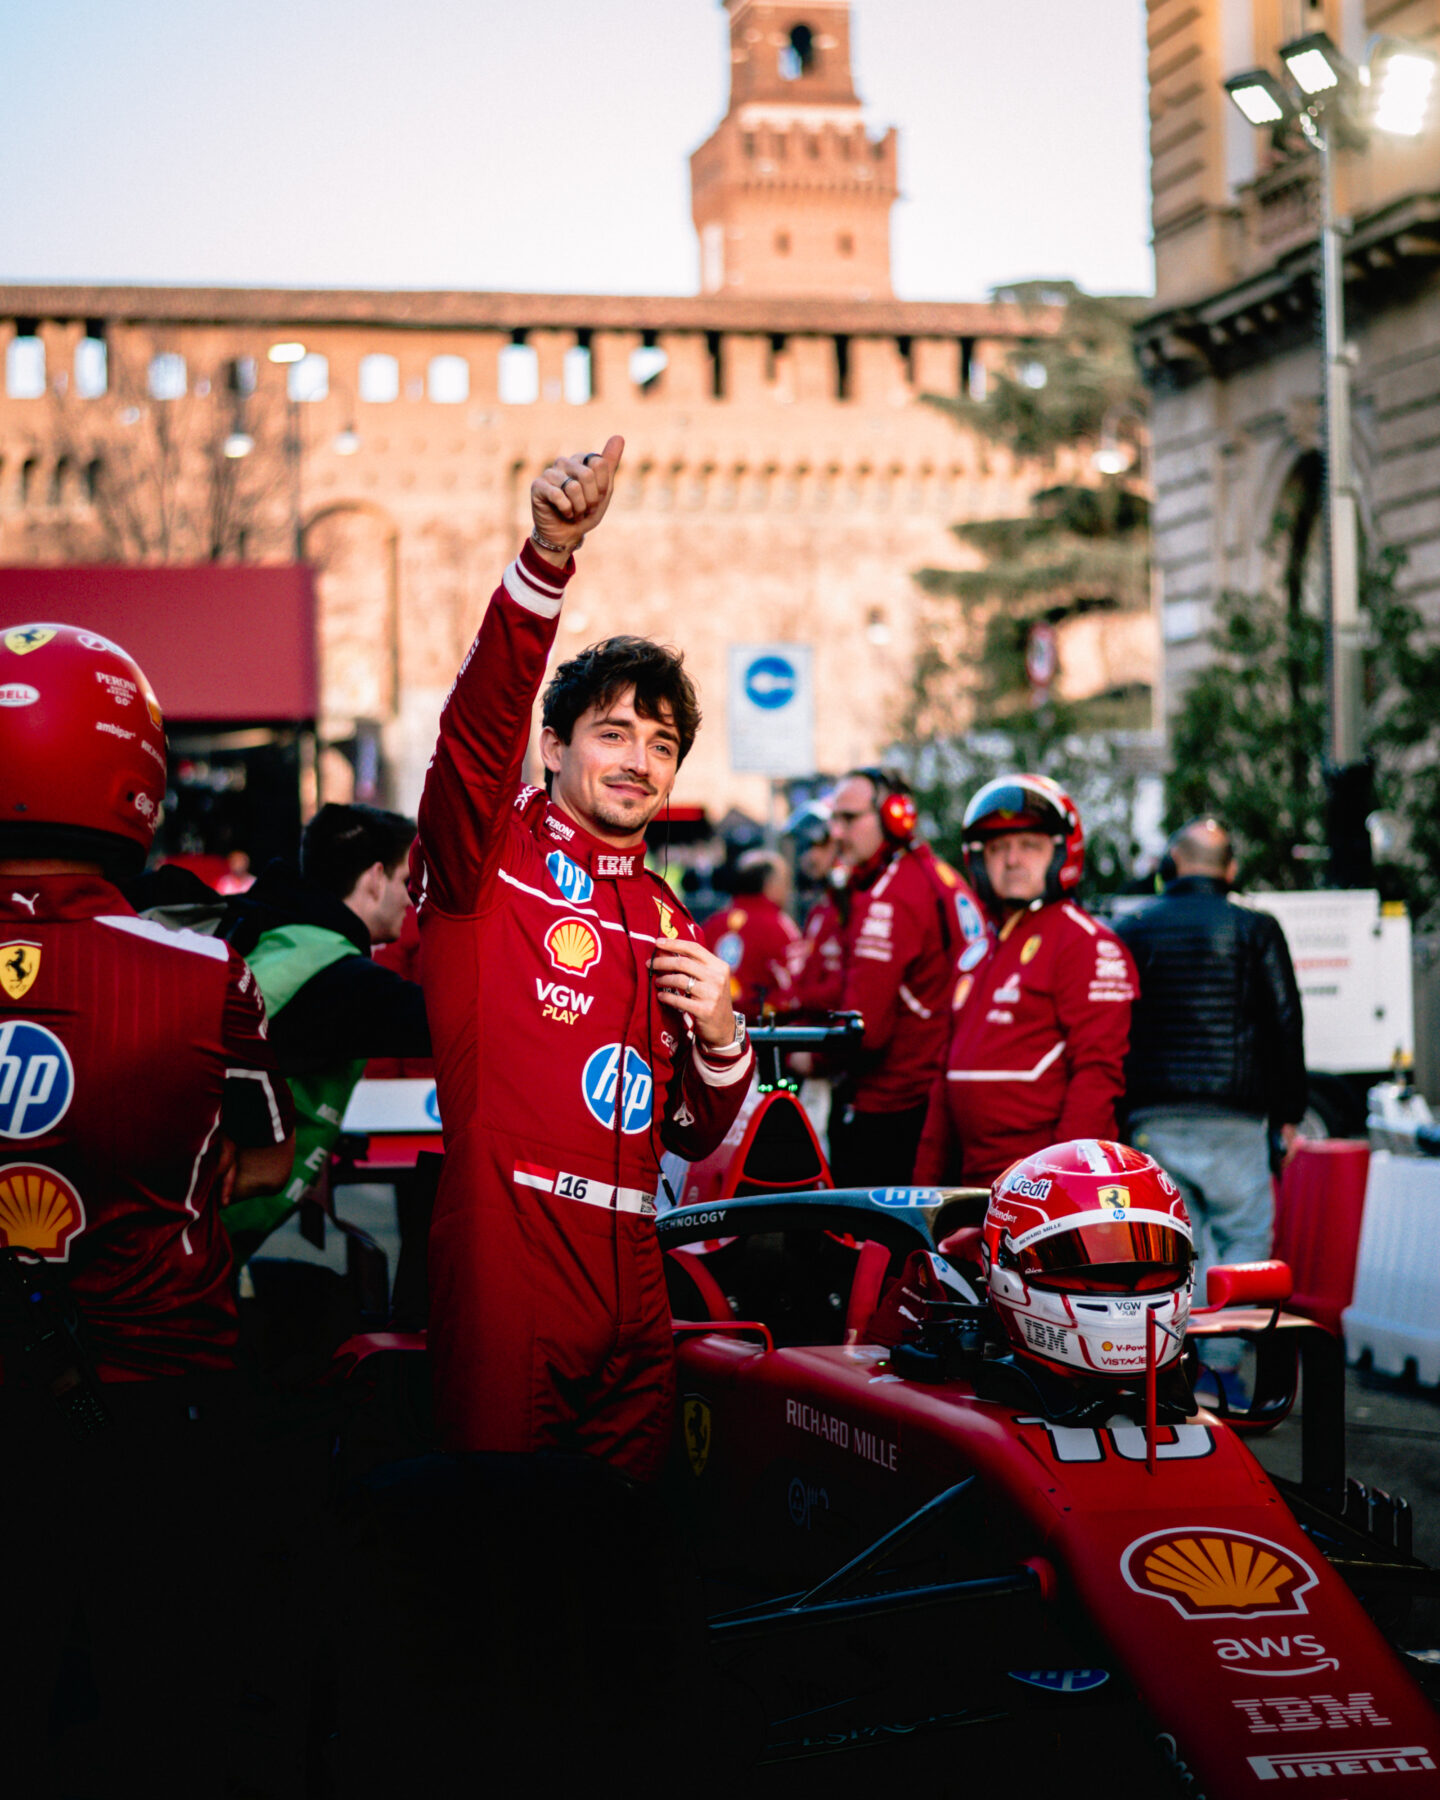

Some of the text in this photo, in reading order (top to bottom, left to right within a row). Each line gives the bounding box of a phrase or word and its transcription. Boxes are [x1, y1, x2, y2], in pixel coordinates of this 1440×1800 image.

[95, 671, 137, 693] PERONI
[545, 815, 575, 839] PERONI
[596, 855, 636, 876] IBM
[535, 977, 595, 1015] VGW
[542, 1004, 580, 1026] PLAY
[589, 1044, 652, 1134] hp
[558, 1176, 588, 1200] 16
[1114, 1302, 1141, 1311] VGW
[1025, 1318, 1068, 1355] IBM
[786, 1398, 897, 1472] RICHARD MILLE
[1212, 1634, 1326, 1661] aws
[1232, 1693, 1392, 1734] IBM
[1246, 1746, 1438, 1780] PIRELLI
